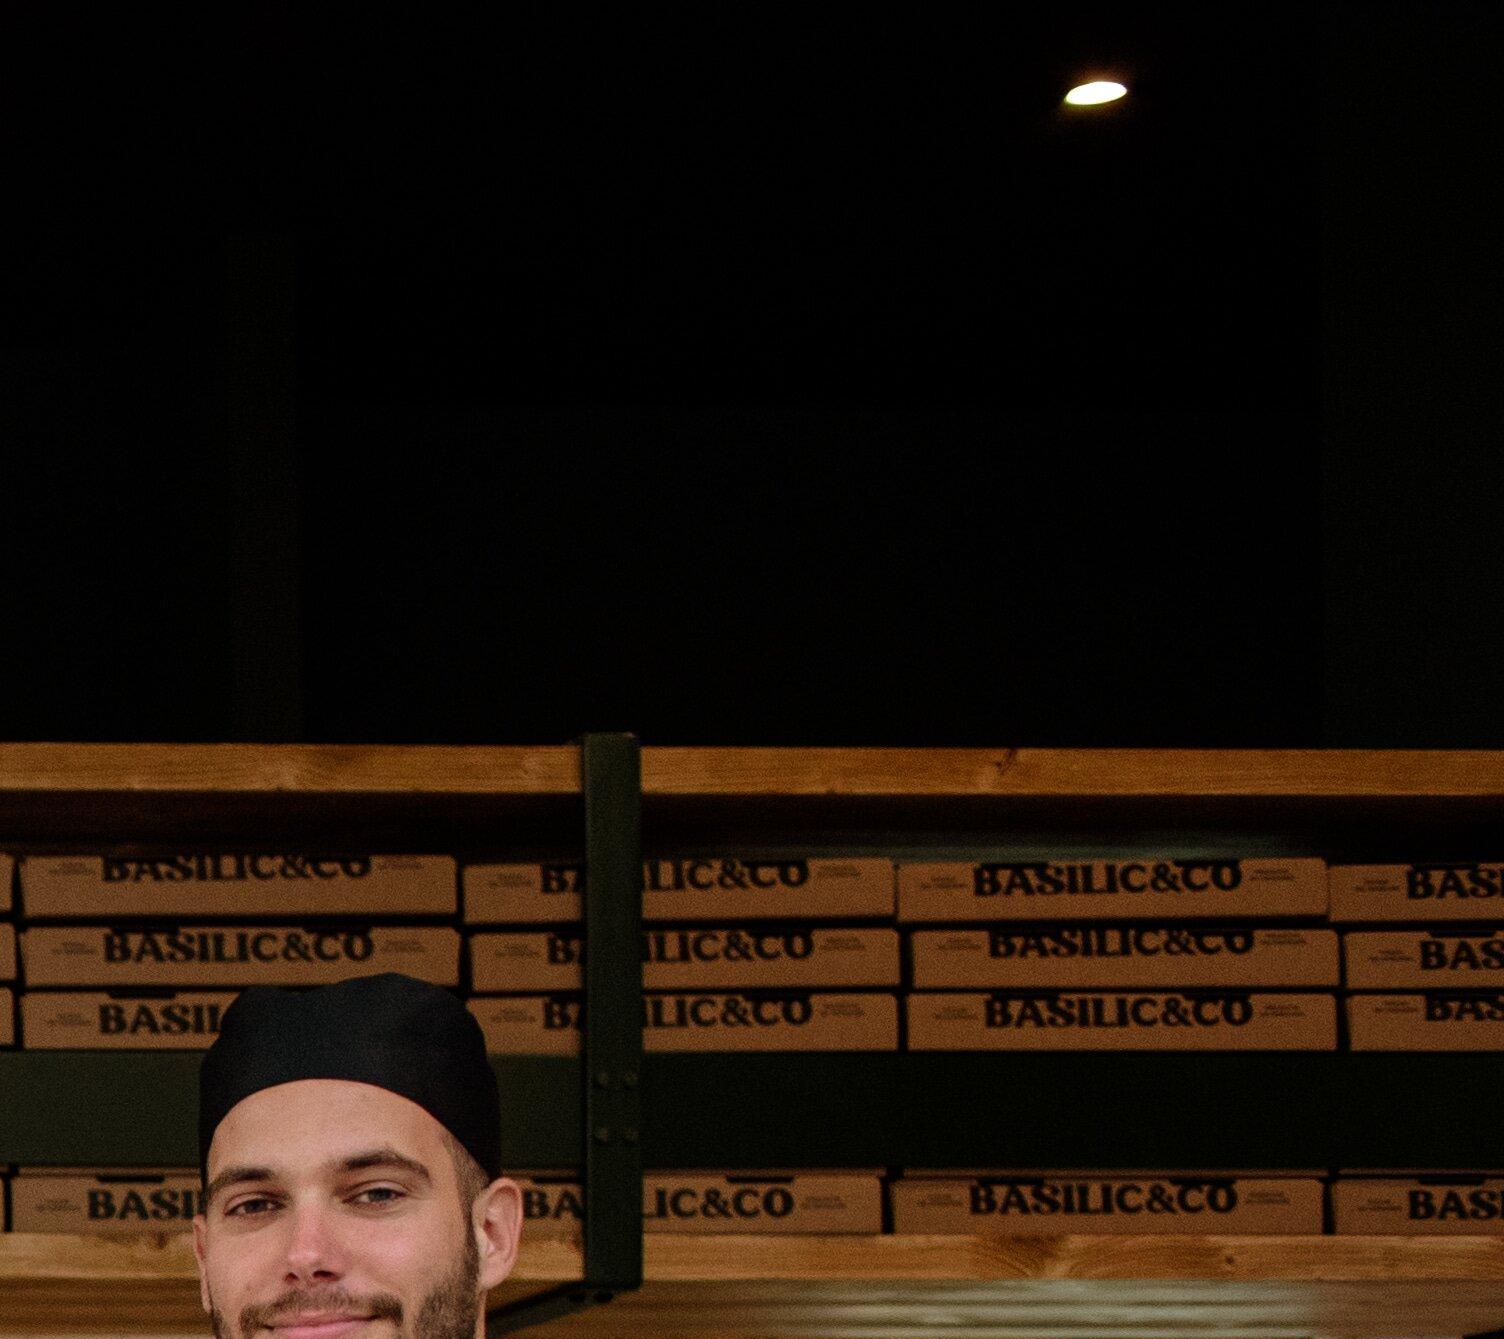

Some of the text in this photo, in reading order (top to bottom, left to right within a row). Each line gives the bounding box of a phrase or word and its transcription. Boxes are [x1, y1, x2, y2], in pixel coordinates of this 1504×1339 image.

[102, 856, 371, 883] BASILIC&CO
[973, 861, 1242, 897] BASILIC&CO
[104, 932, 374, 963] BASILIC&CO
[988, 929, 1255, 958] BASILIC&CO
[984, 997, 1254, 1028] BASILIC&CO
[969, 1183, 1238, 1214] BASILIC&CO
